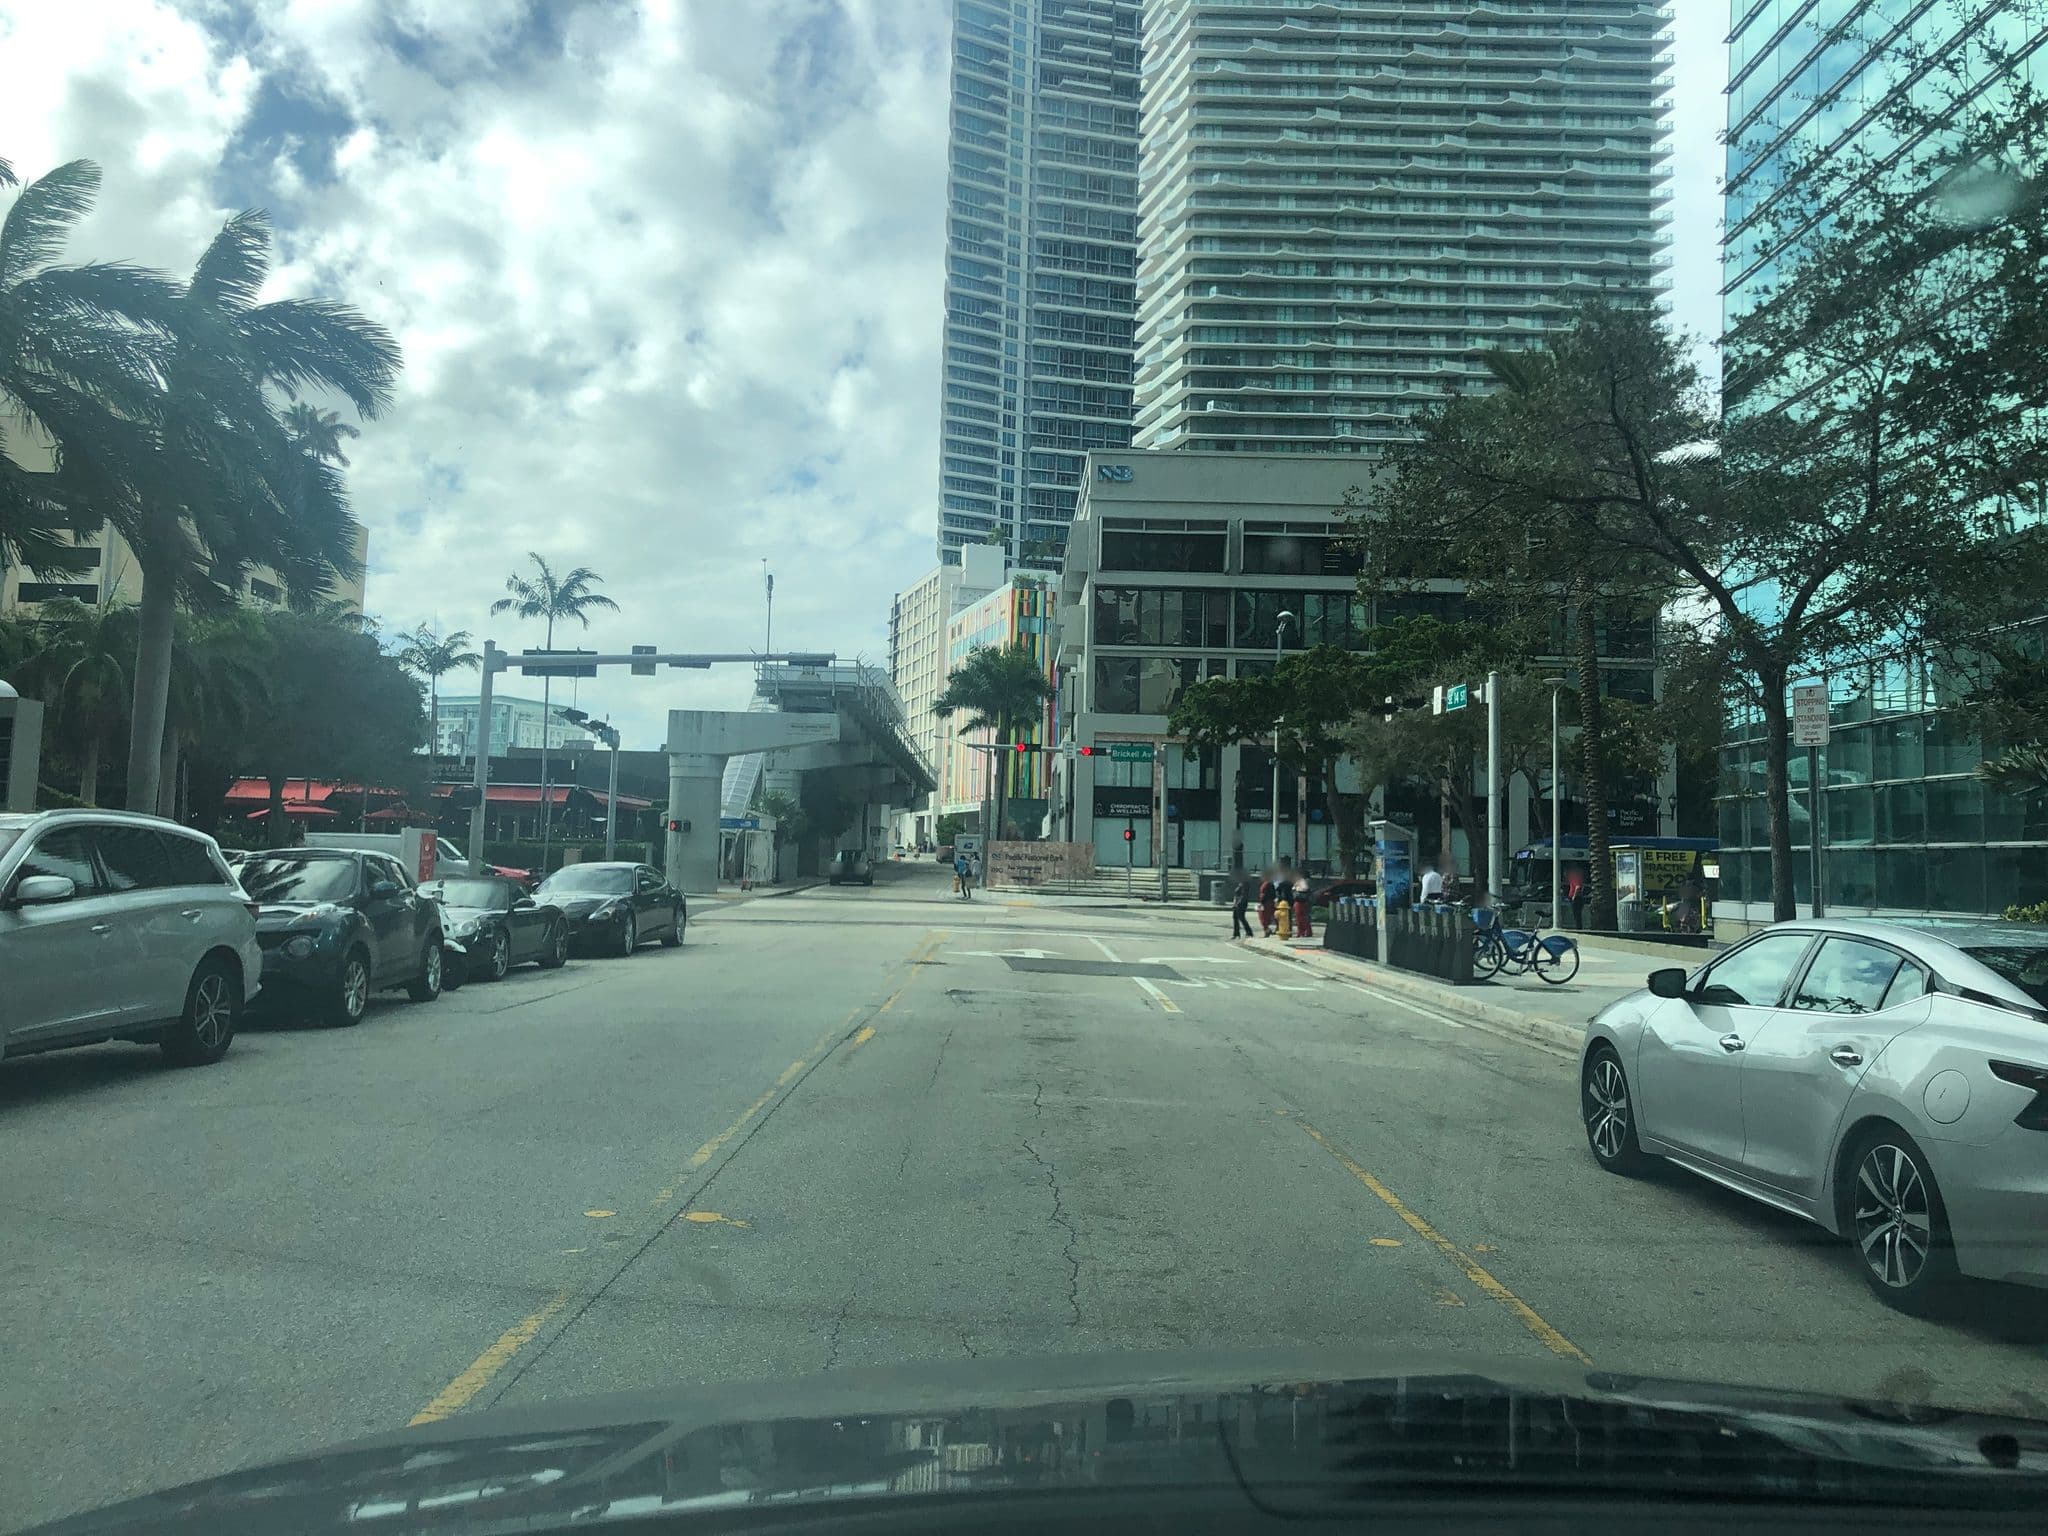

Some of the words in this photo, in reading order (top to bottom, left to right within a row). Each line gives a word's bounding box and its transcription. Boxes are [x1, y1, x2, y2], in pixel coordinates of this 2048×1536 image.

[1806, 689, 1815, 698] NO
[1796, 698, 1825, 706] STOPPING
[1796, 714, 1826, 723] STANDING
[1112, 749, 1139, 758] Brickell
[1656, 851, 1687, 862] FREE
